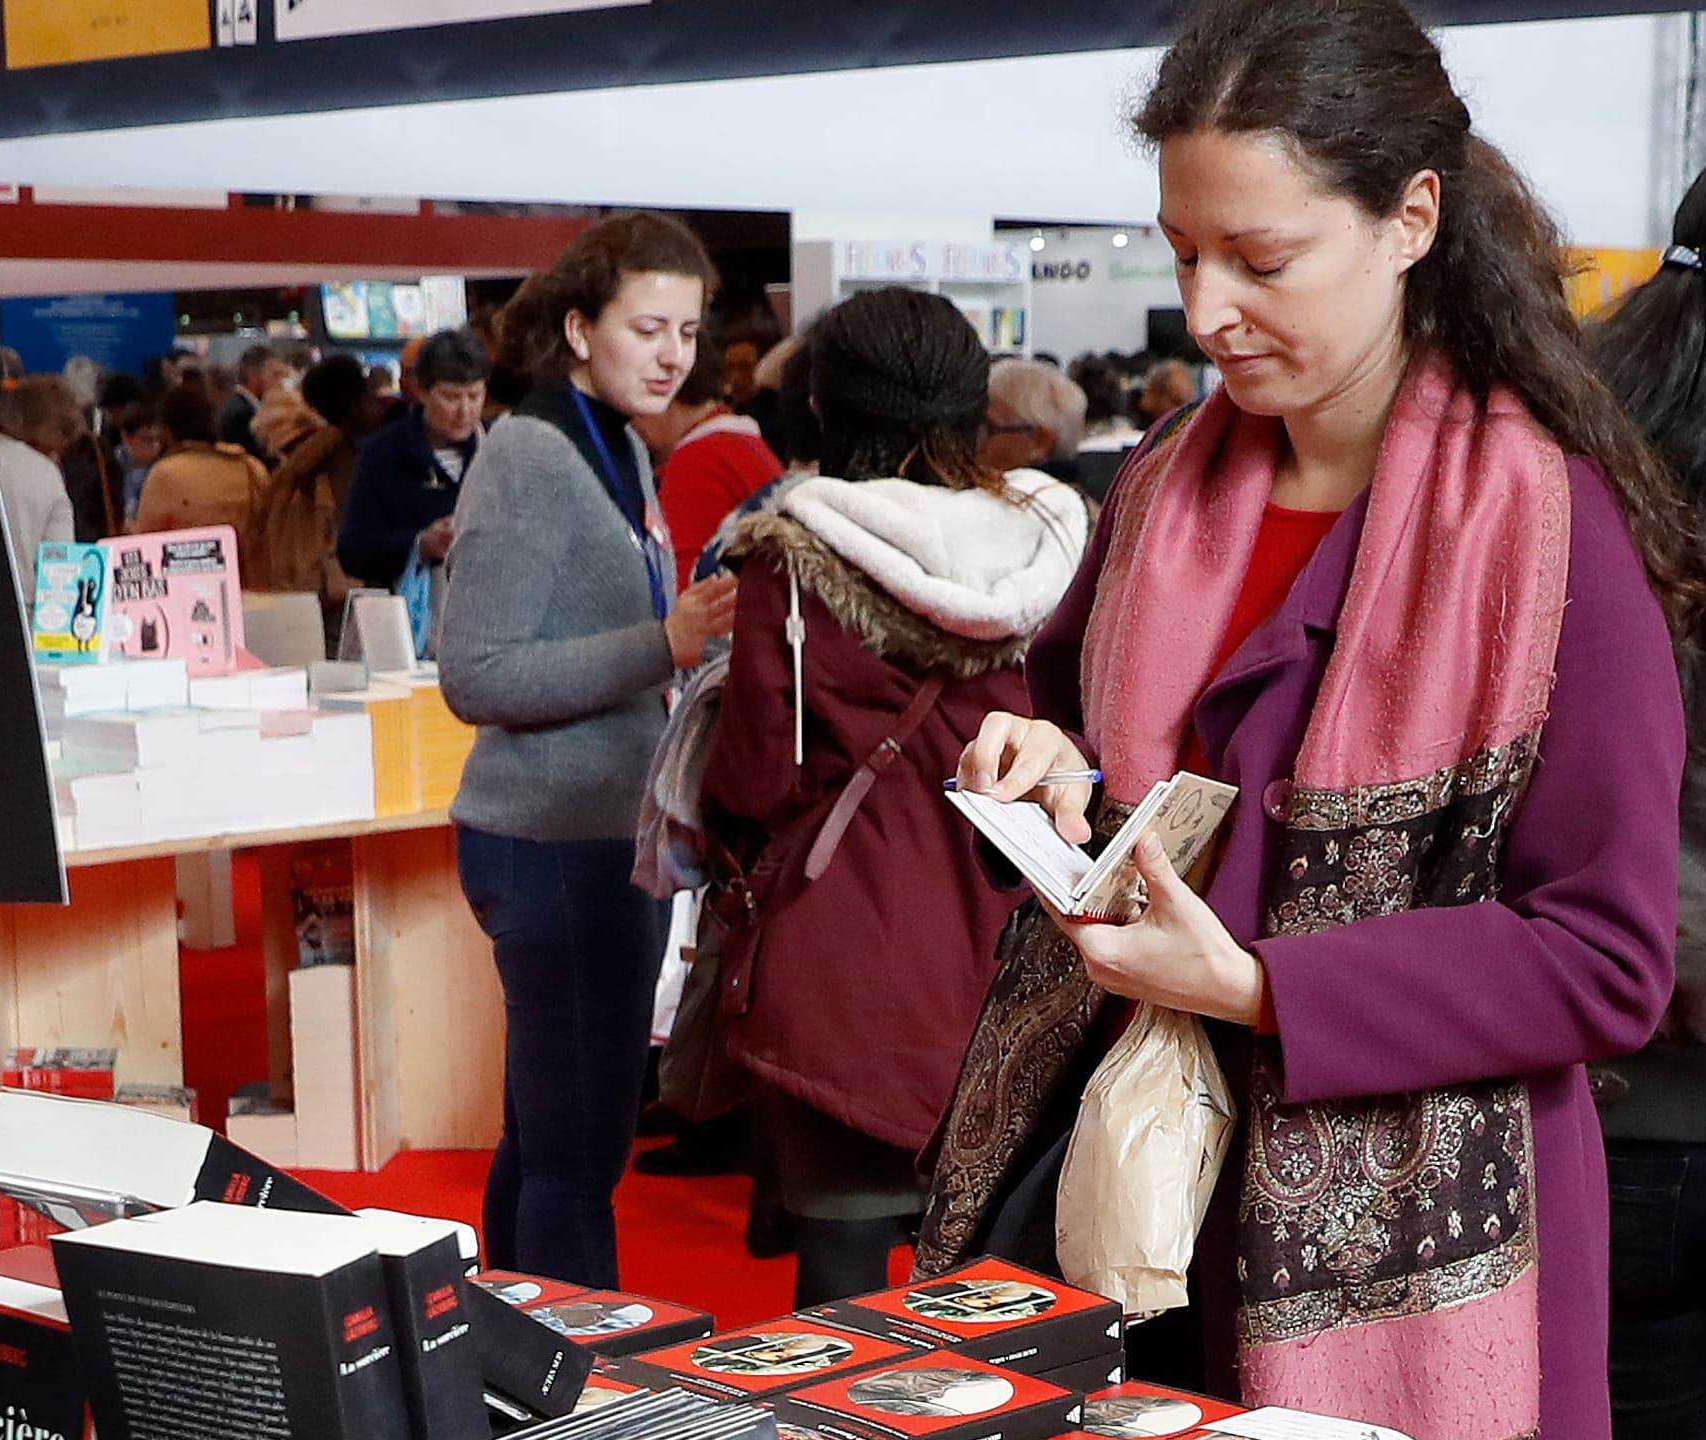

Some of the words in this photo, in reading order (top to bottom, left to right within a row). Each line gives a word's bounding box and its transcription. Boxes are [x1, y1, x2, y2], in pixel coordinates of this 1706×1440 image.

[422, 1339, 438, 1352] La
[339, 1362, 356, 1376] La
[355, 1345, 391, 1369] sorcière
